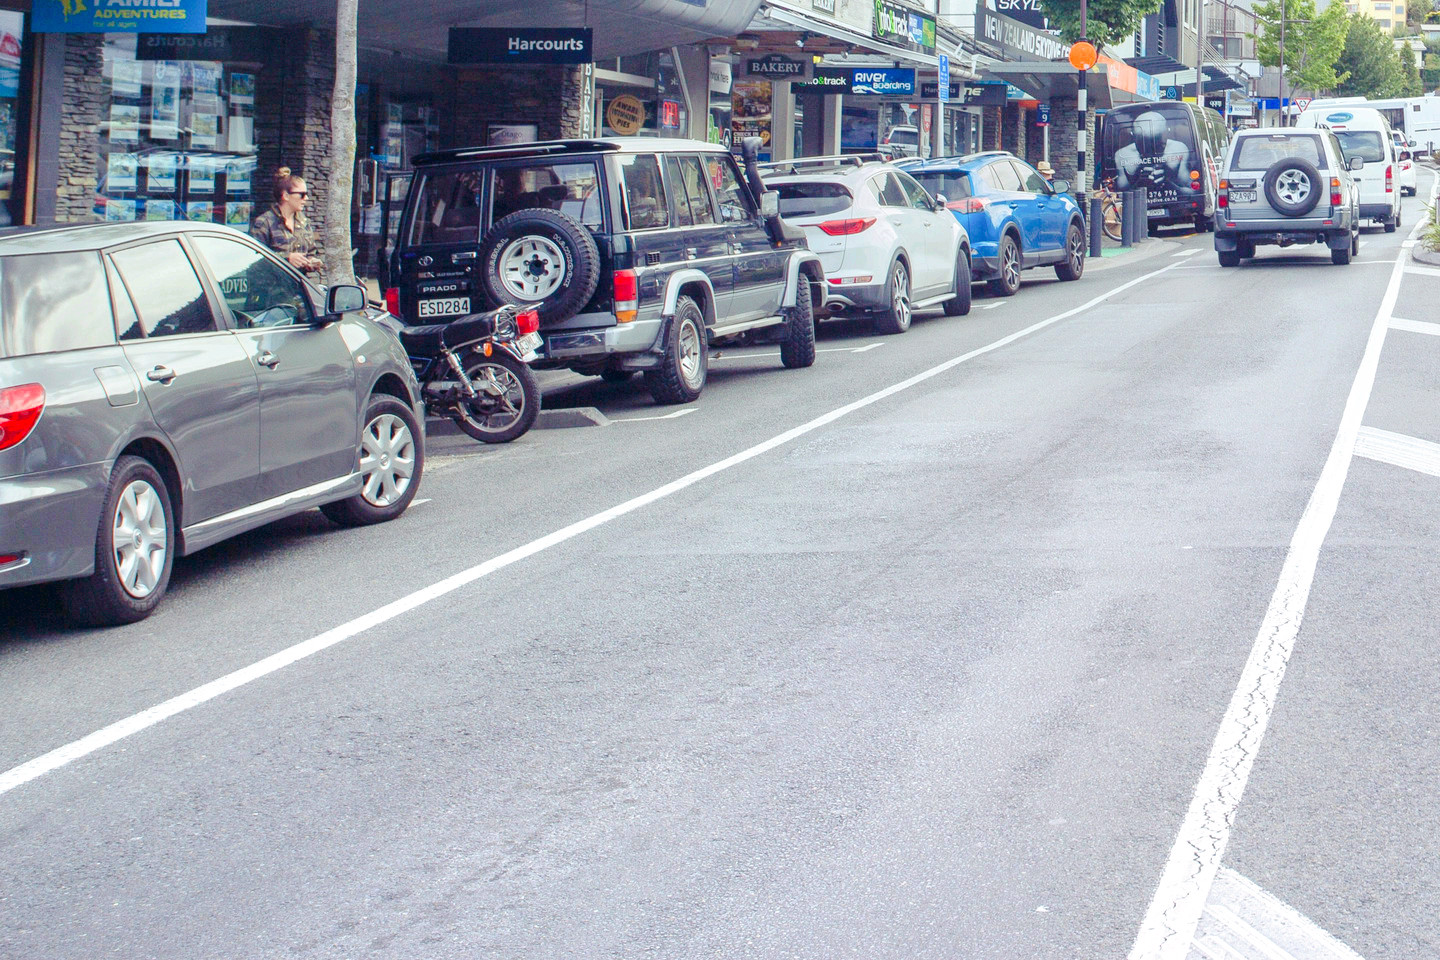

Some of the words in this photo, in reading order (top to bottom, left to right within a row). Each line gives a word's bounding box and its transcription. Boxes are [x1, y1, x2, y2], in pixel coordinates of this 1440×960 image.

[93, 9, 187, 19] ADVENTURES
[985, 14, 1001, 41] NEW
[1004, 21, 1035, 53] ZEALAND
[508, 37, 584, 51] Harcourts
[752, 62, 801, 73] BAKERY
[1042, 114, 1048, 122] 9
[1121, 157, 1152, 166] EMBRACE
[1152, 156, 1166, 164] THE
[423, 284, 457, 293] PRADO
[420, 299, 469, 316] ESD284
